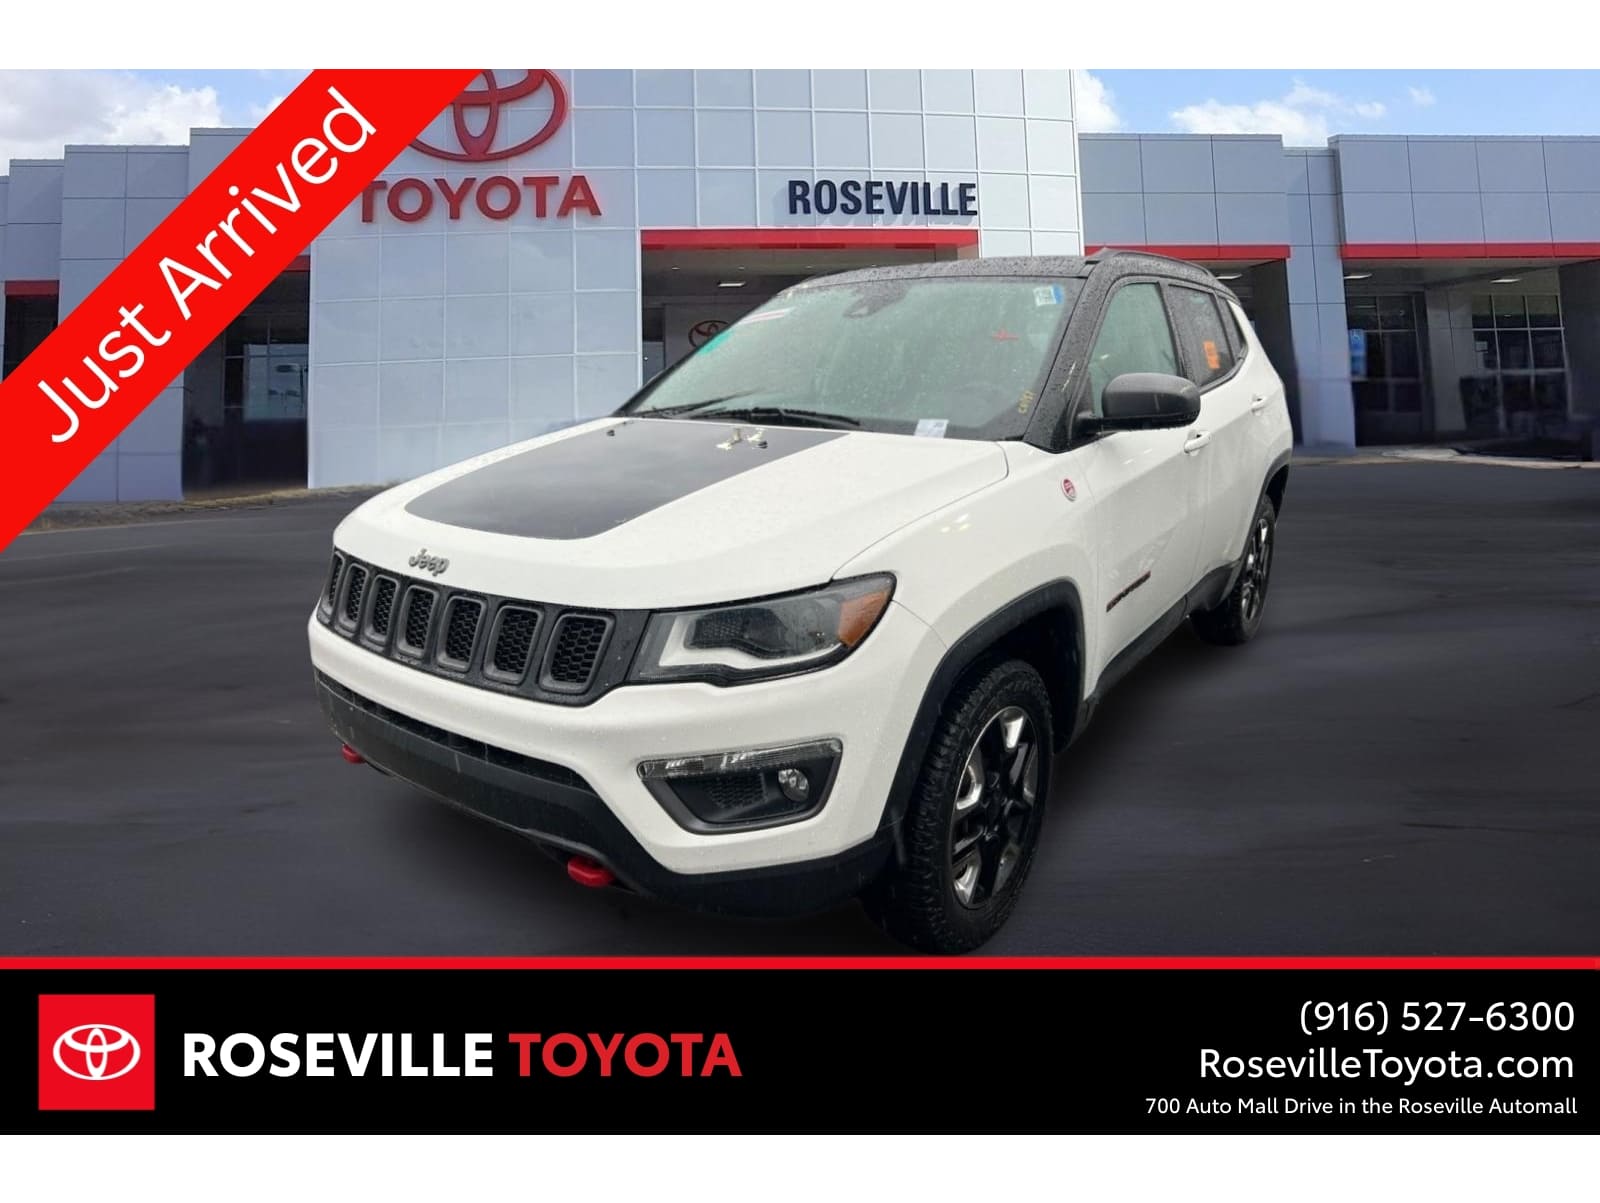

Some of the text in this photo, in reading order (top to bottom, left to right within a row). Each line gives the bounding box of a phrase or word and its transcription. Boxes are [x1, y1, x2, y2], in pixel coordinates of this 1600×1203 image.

[361, 175, 602, 223] TOYOTA
[787, 179, 978, 216] ROSEVILLE
[408, 548, 450, 577] Jeep
